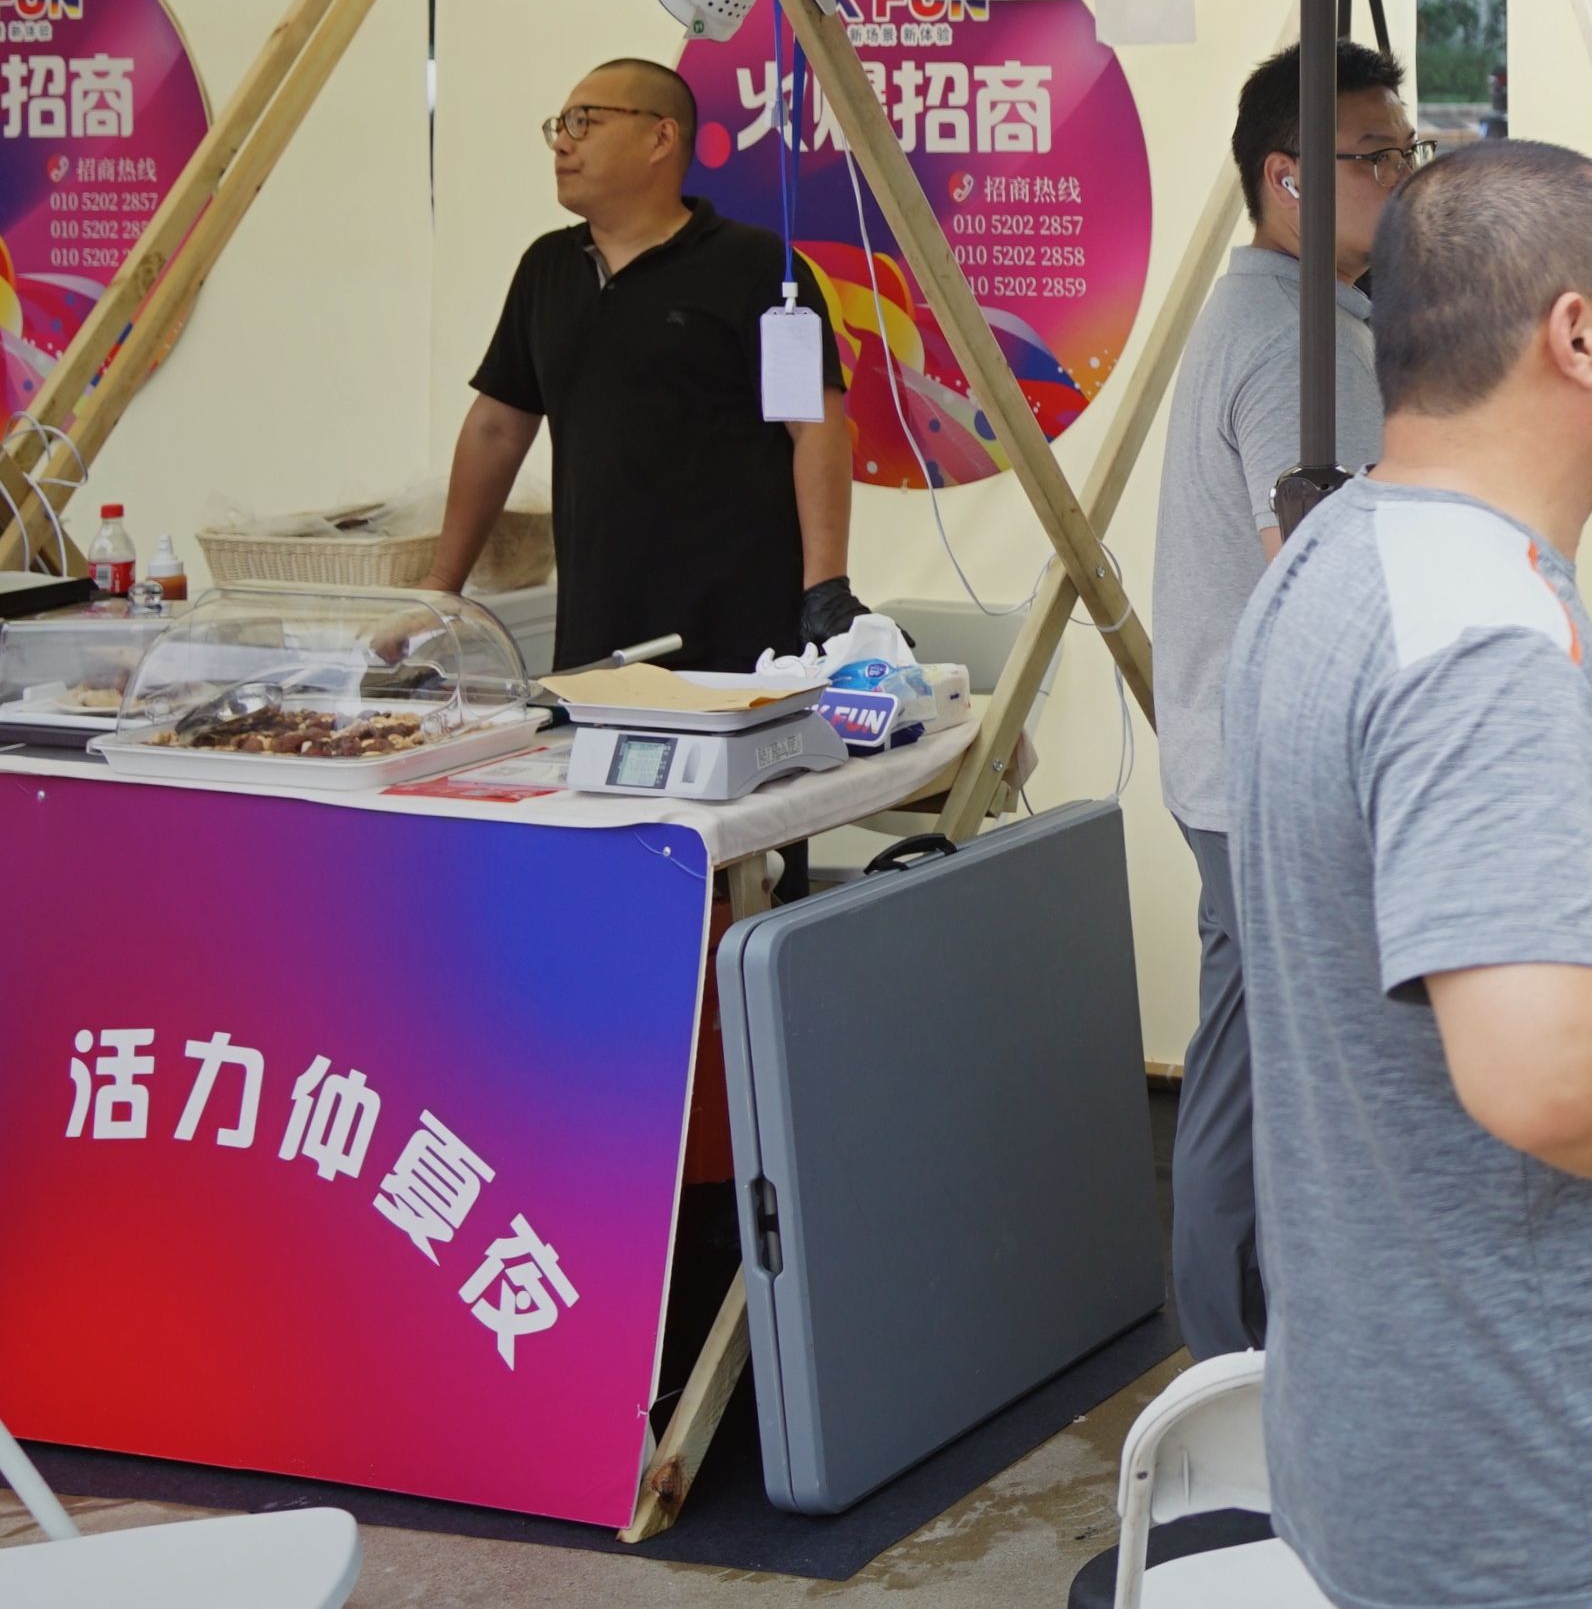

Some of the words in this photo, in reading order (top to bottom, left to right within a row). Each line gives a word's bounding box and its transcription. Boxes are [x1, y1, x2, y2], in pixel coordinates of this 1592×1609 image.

[849, 24, 898, 46] 新场景
[901, 24, 953, 46] 新体验
[1, 53, 135, 139] 招商
[76, 157, 158, 182] 招商热线
[983, 176, 1082, 204] 招商热线
[50, 192, 79, 211] 010
[81, 192, 118, 211] 5202
[121, 192, 158, 211] 2857
[50, 220, 79, 239] 010
[82, 220, 119, 239] 5202
[122, 220, 152, 239] 285
[952, 214, 986, 235] 010
[991, 214, 1035, 236] 5202
[1039, 215, 1084, 236] 2857
[50, 248, 79, 267] 010
[82, 248, 119, 267] 5202
[954, 245, 987, 265] 010
[992, 245, 1036, 266] 5202
[1041, 246, 1086, 267] 2858
[967, 276, 989, 296] 10
[994, 276, 1038, 297] 5202
[1042, 277, 1087, 298] 2859
[831, 705, 887, 735] FUN
[65, 1027, 580, 1371] 活力仲夏夜
